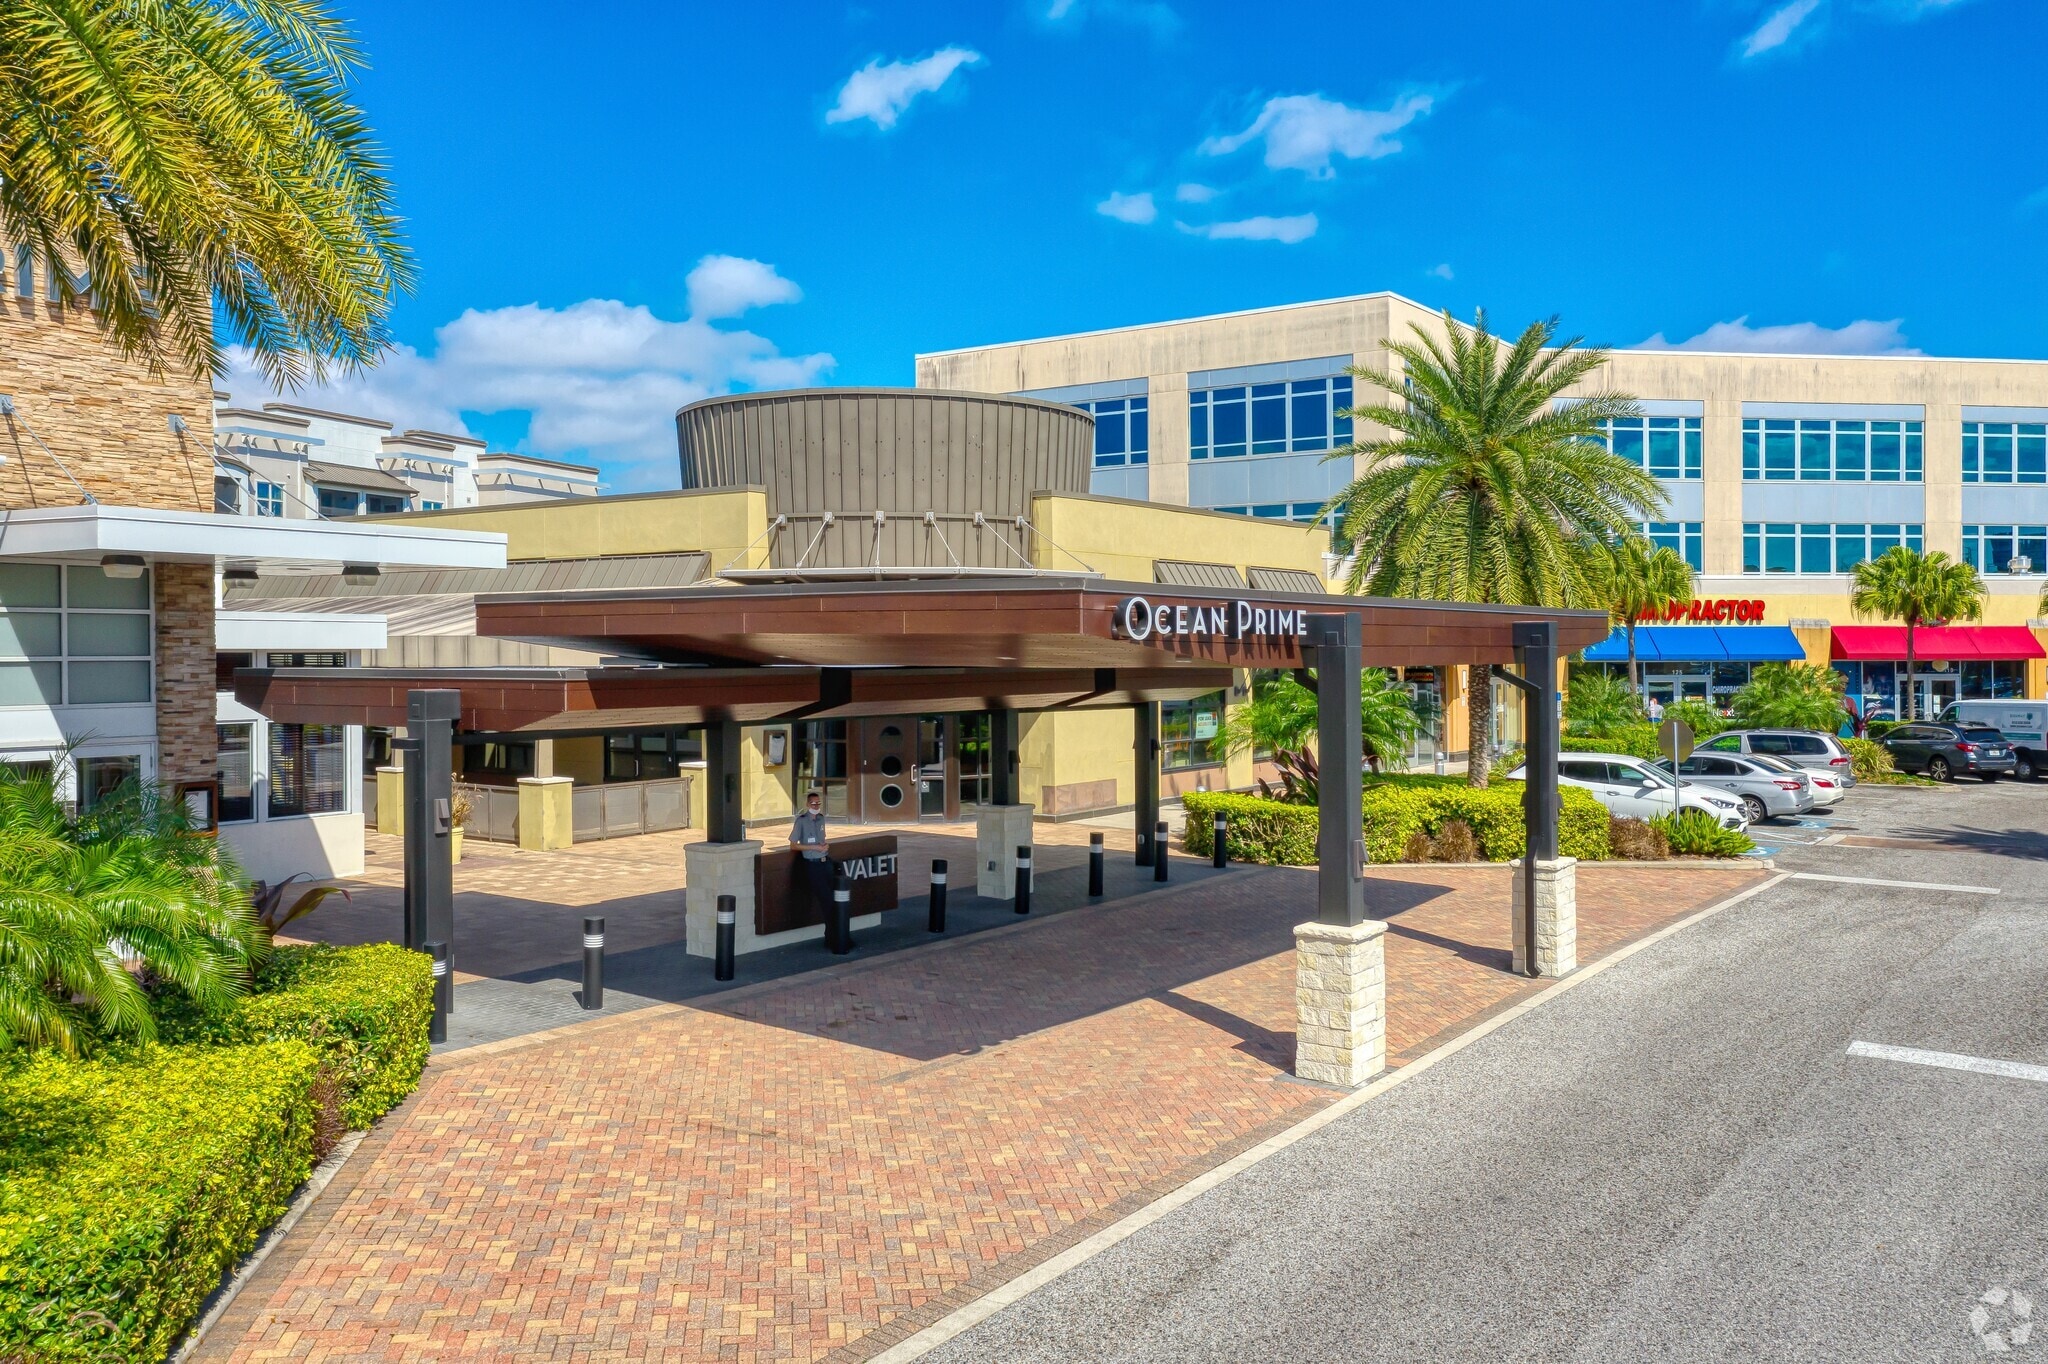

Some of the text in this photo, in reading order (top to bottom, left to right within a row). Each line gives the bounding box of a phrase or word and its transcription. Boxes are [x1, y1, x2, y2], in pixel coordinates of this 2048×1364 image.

[1125, 596, 1308, 641] OCEAN PRIME
[843, 853, 898, 880] VALET
